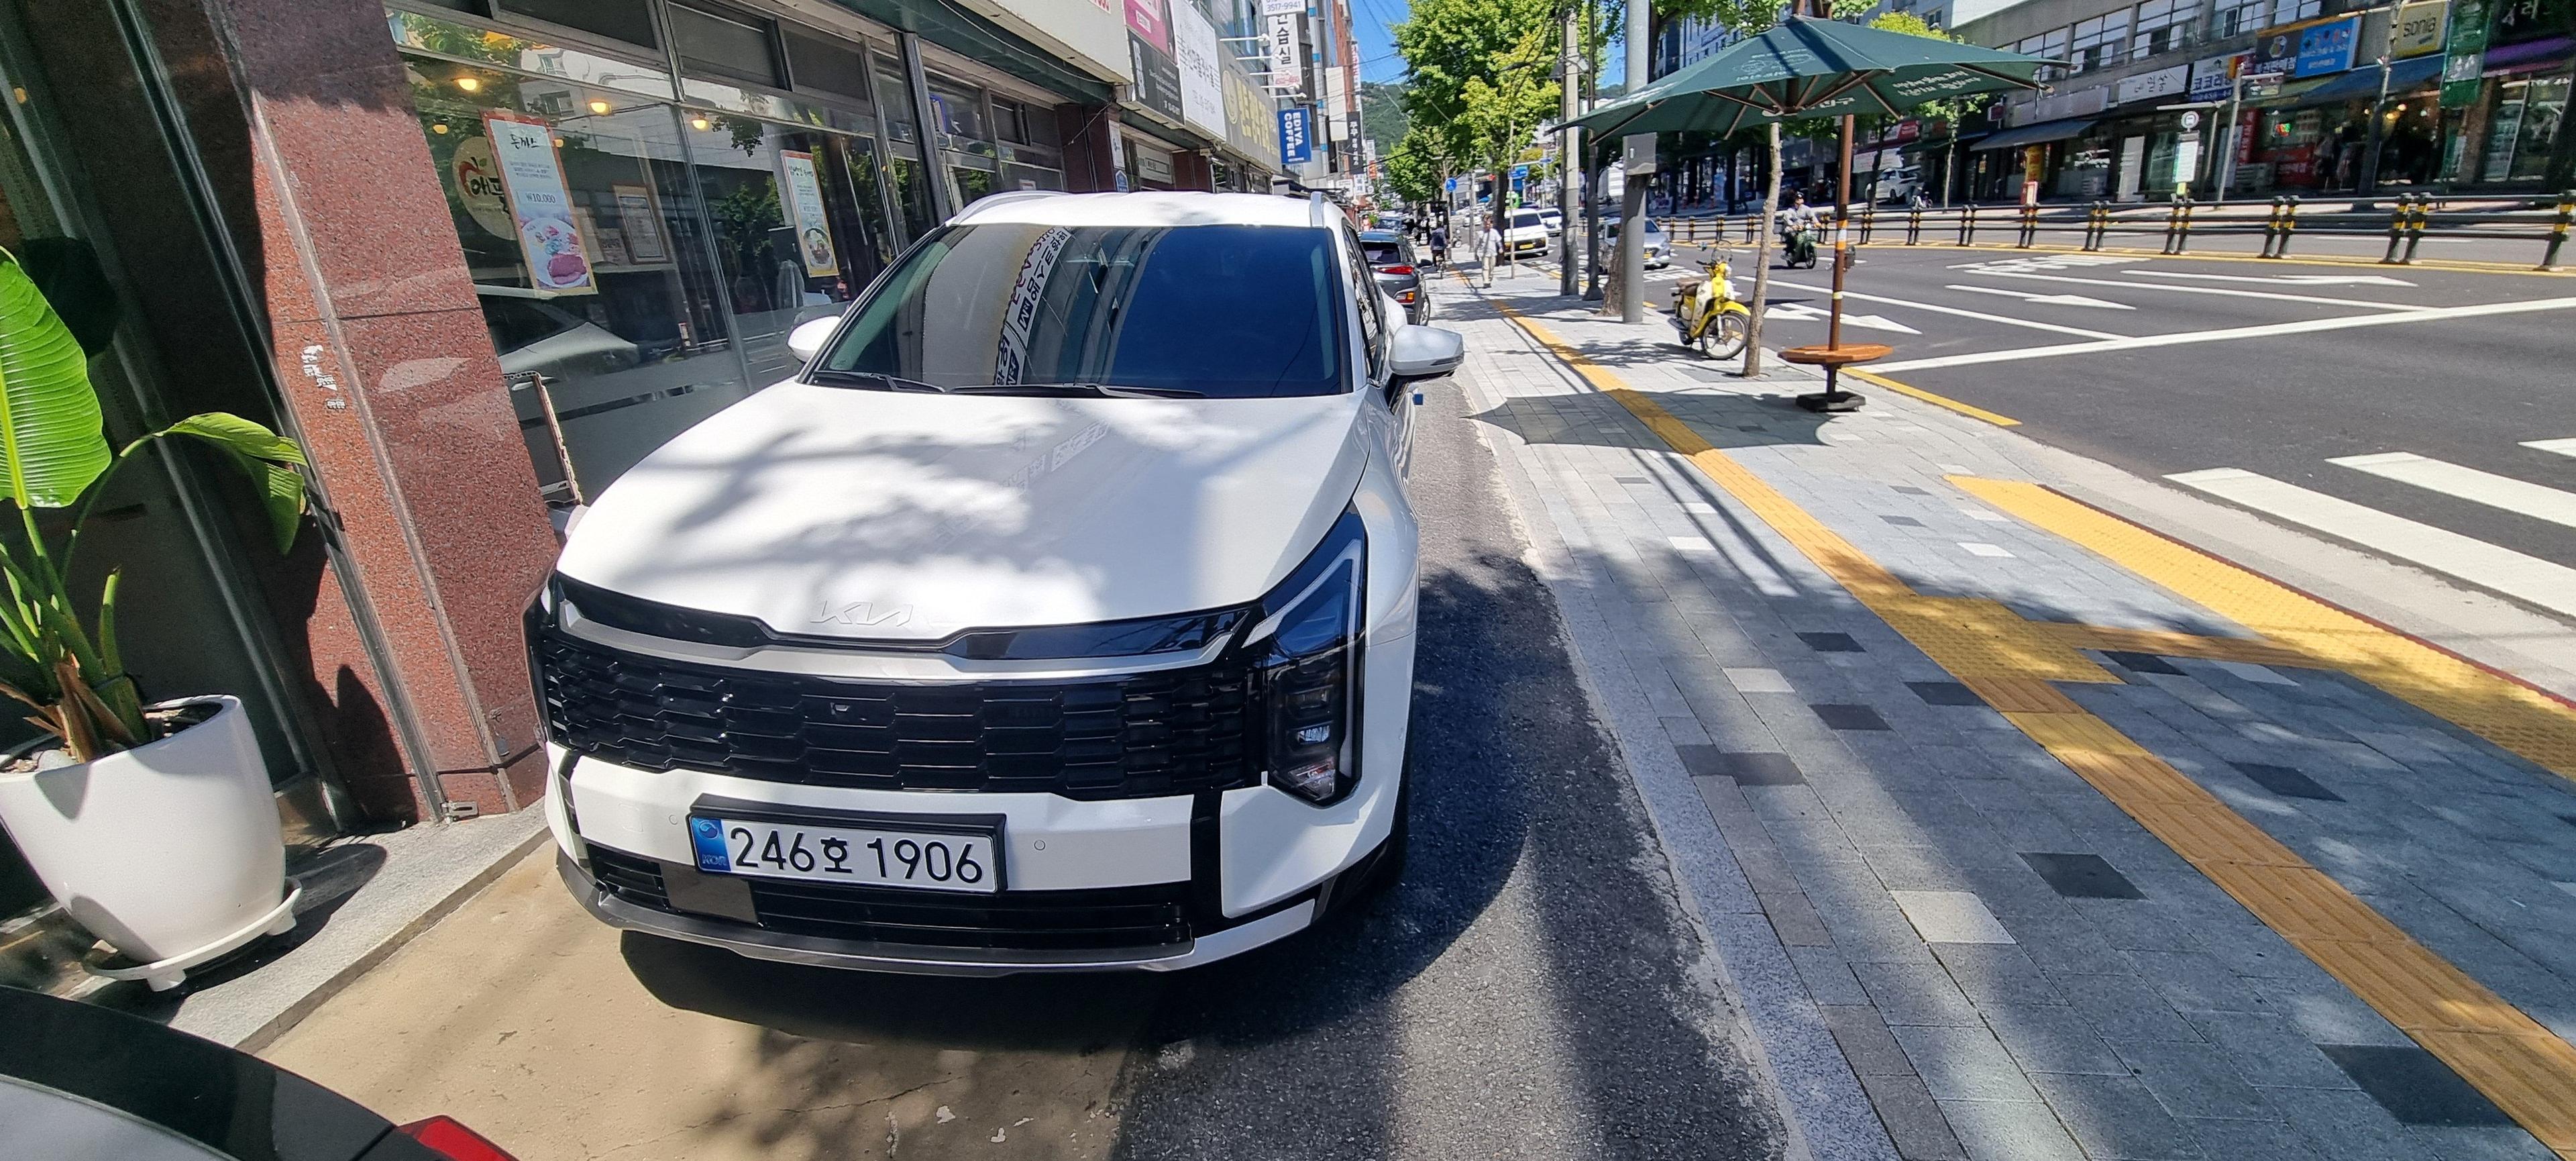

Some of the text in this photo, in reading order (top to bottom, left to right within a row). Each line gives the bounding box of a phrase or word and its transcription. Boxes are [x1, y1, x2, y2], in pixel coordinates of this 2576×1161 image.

[510, 133, 540, 150] 돈까스
[1284, 113, 1295, 157] COFFEE
[1293, 112, 1303, 146] EDIYA
[730, 826, 983, 884] 246호 1906
